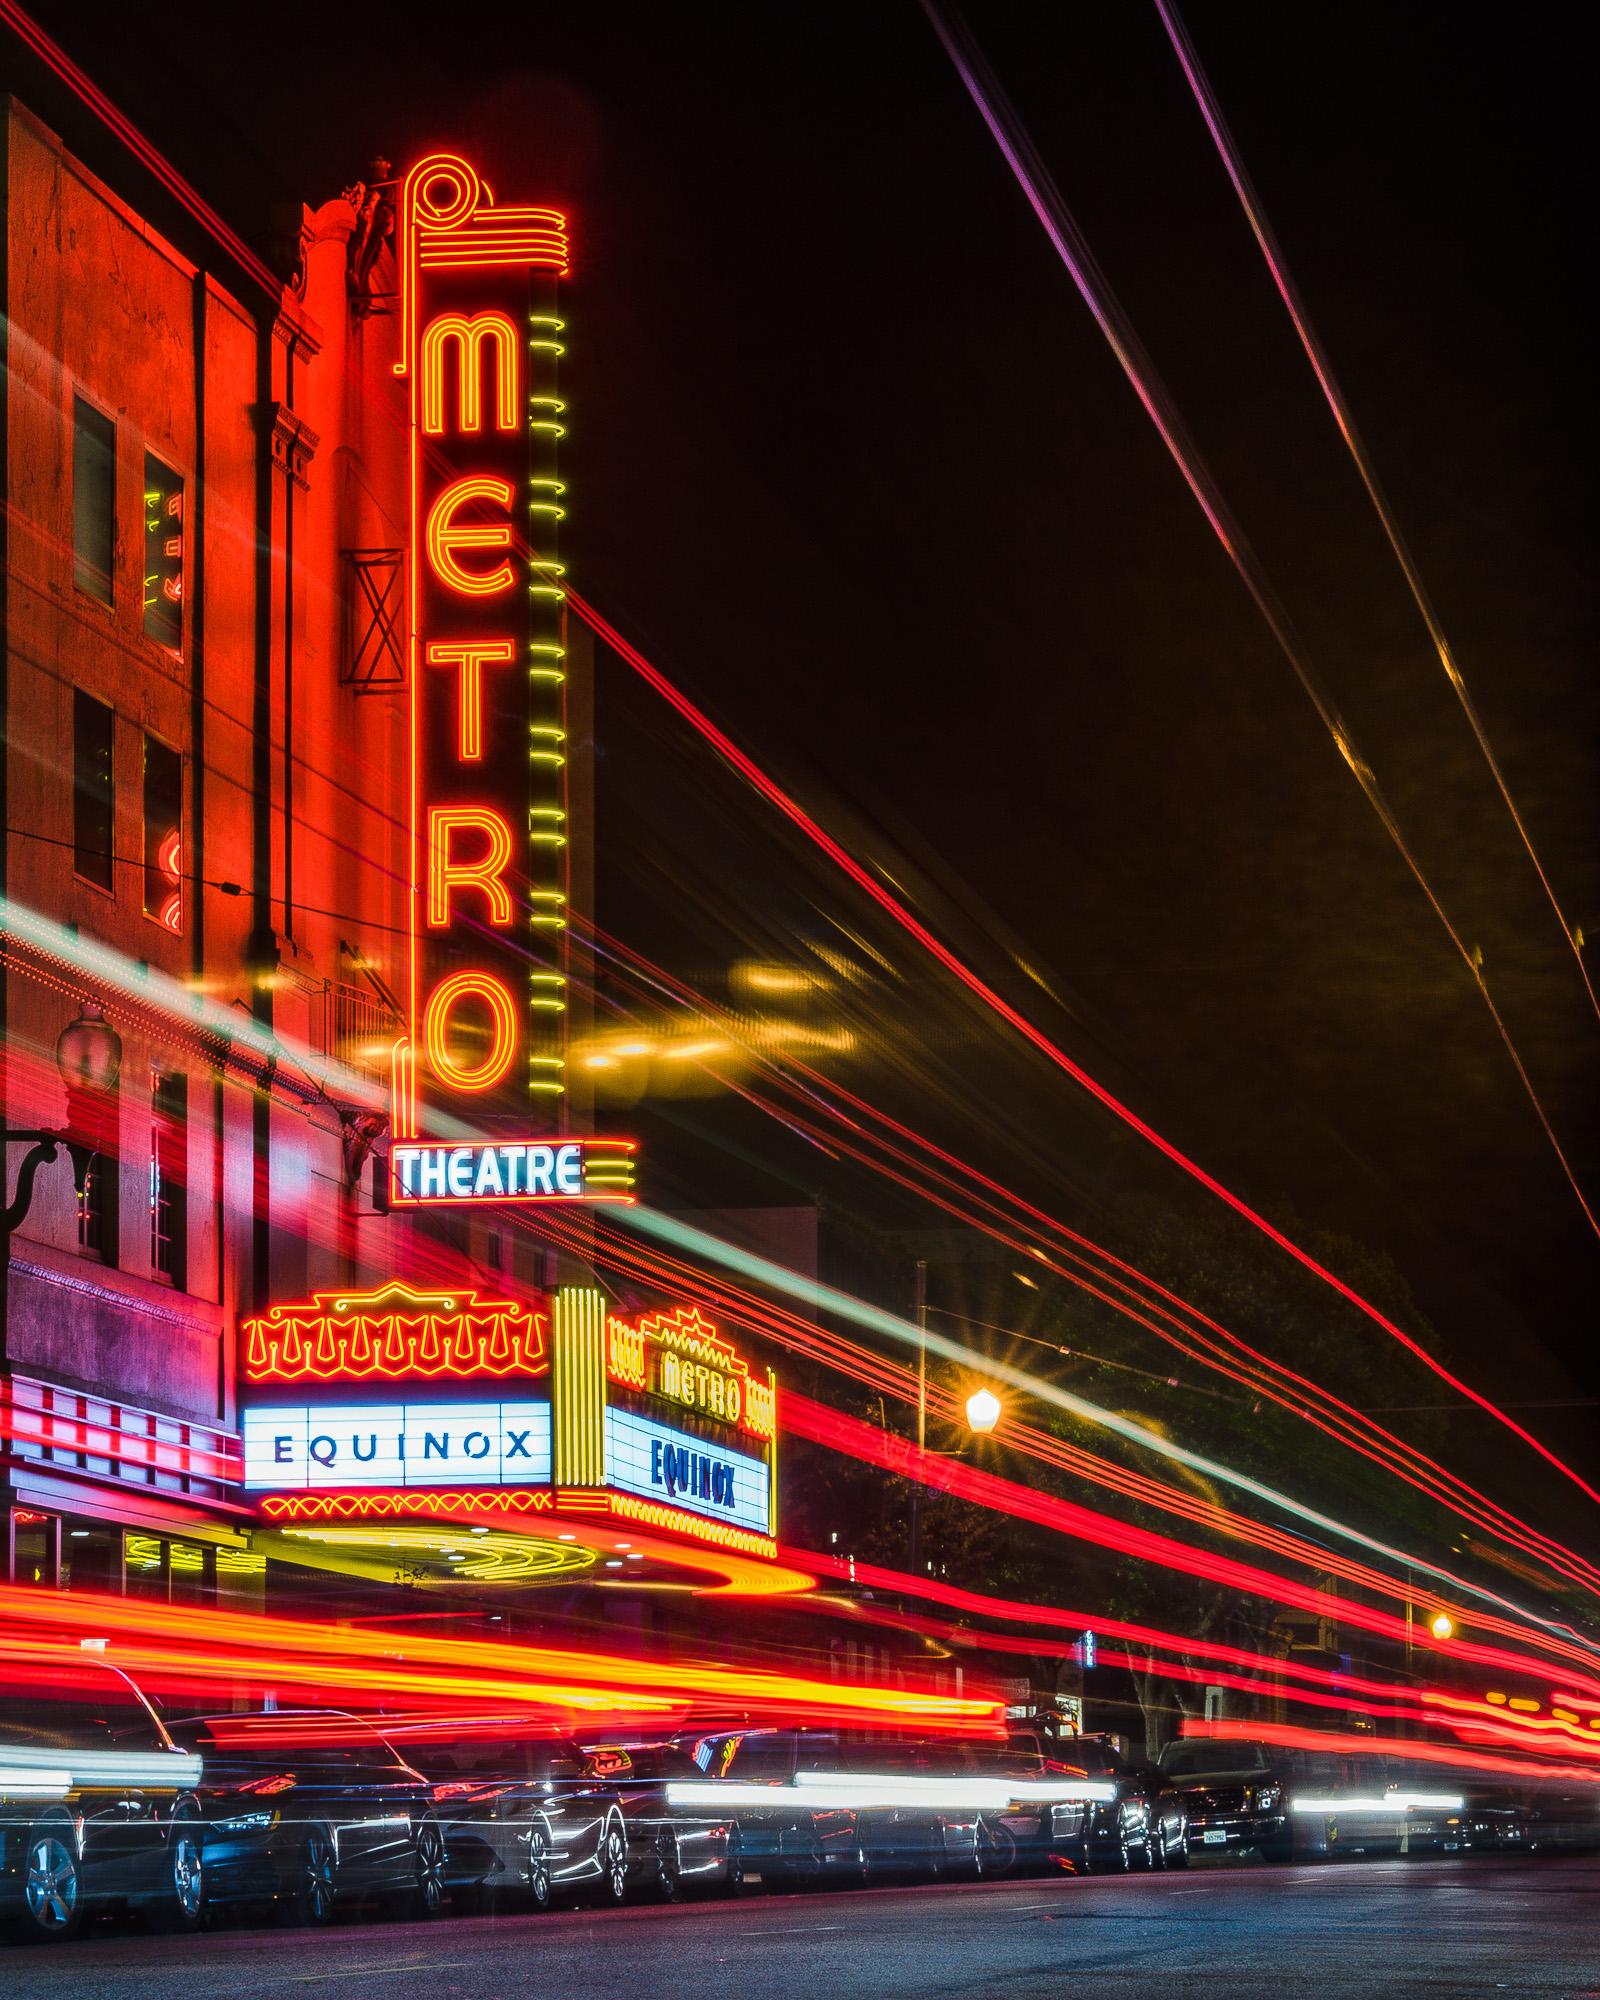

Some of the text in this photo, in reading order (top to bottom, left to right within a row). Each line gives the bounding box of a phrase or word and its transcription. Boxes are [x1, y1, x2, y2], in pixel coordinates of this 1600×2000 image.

[421, 309, 519, 1095] METRO
[394, 1145, 582, 1198] THEATRE
[661, 1351, 742, 1423] METRO
[273, 1430, 532, 1469] EQUINOX
[651, 1439, 736, 1509] EQUINOX
